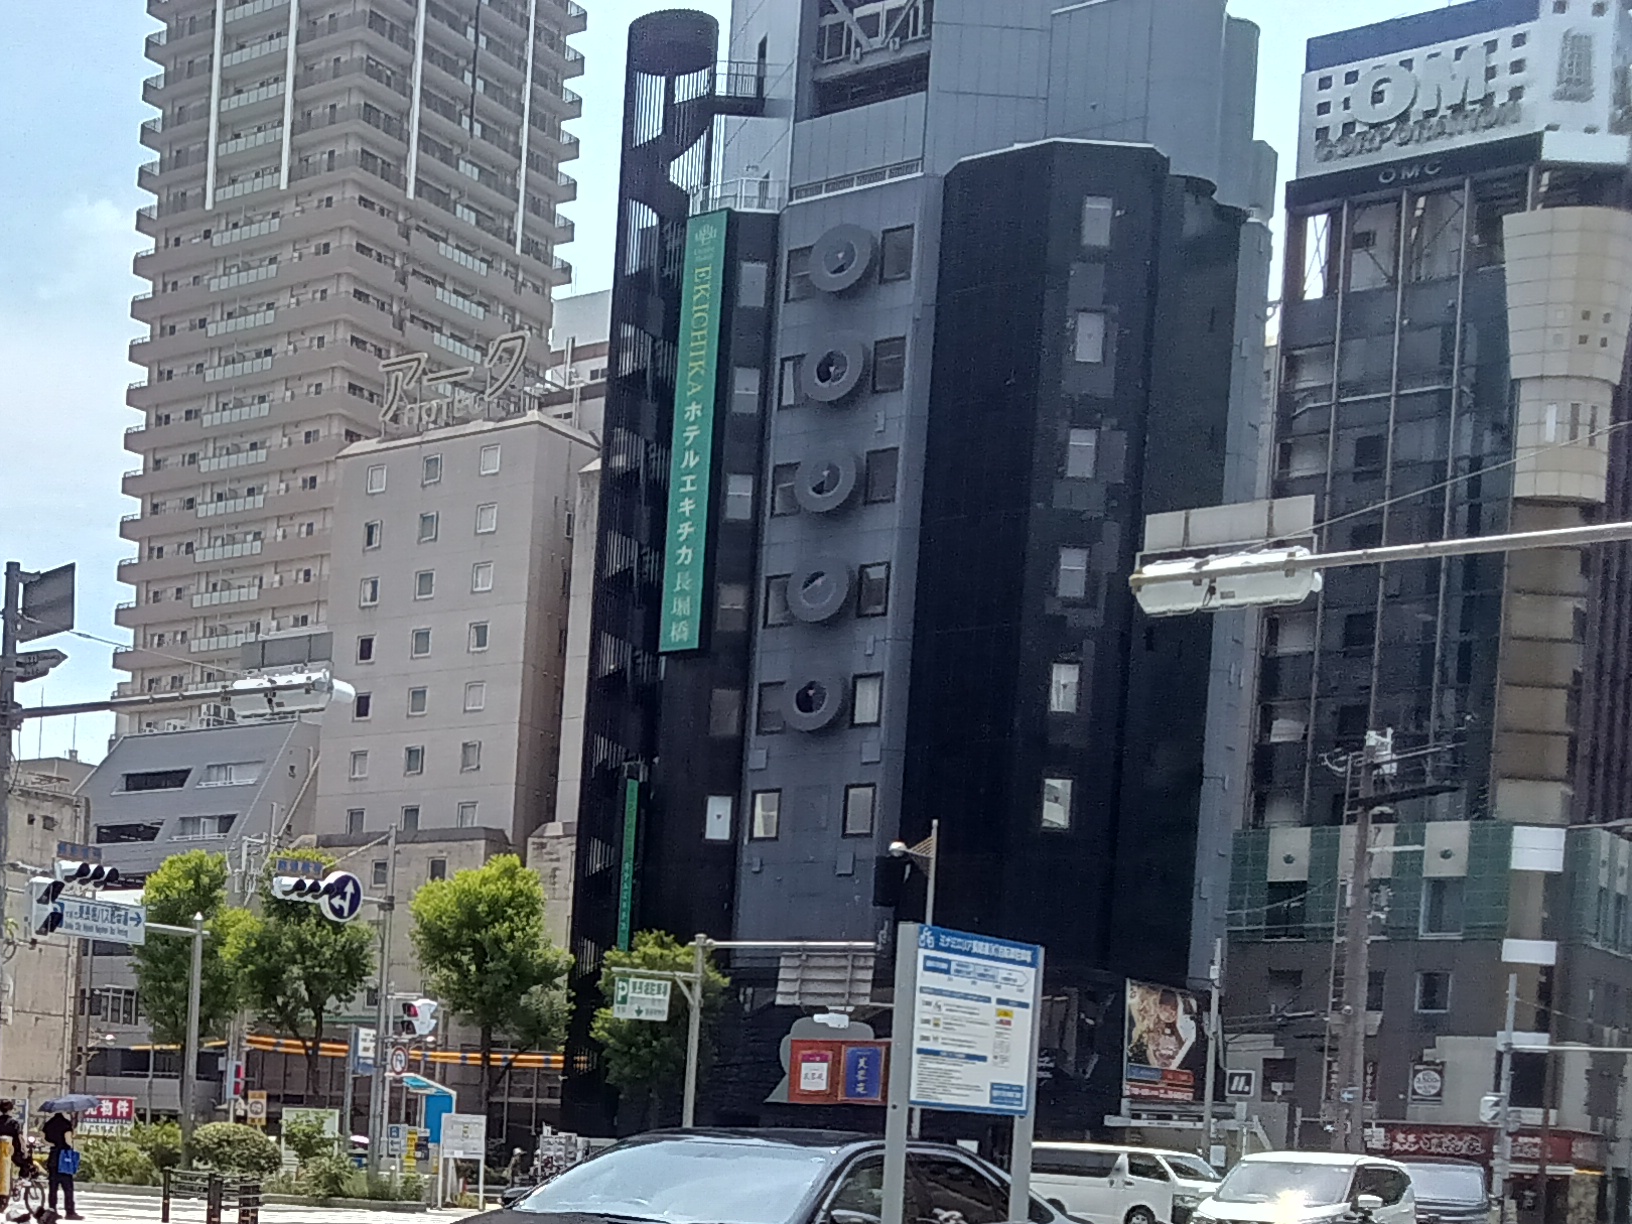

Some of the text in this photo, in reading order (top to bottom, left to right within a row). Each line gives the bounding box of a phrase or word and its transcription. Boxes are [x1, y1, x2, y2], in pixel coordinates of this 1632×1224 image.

[1378, 161, 1442, 184] OMC
[379, 329, 531, 422] アーク
[686, 264, 712, 397] EKICHIKA
